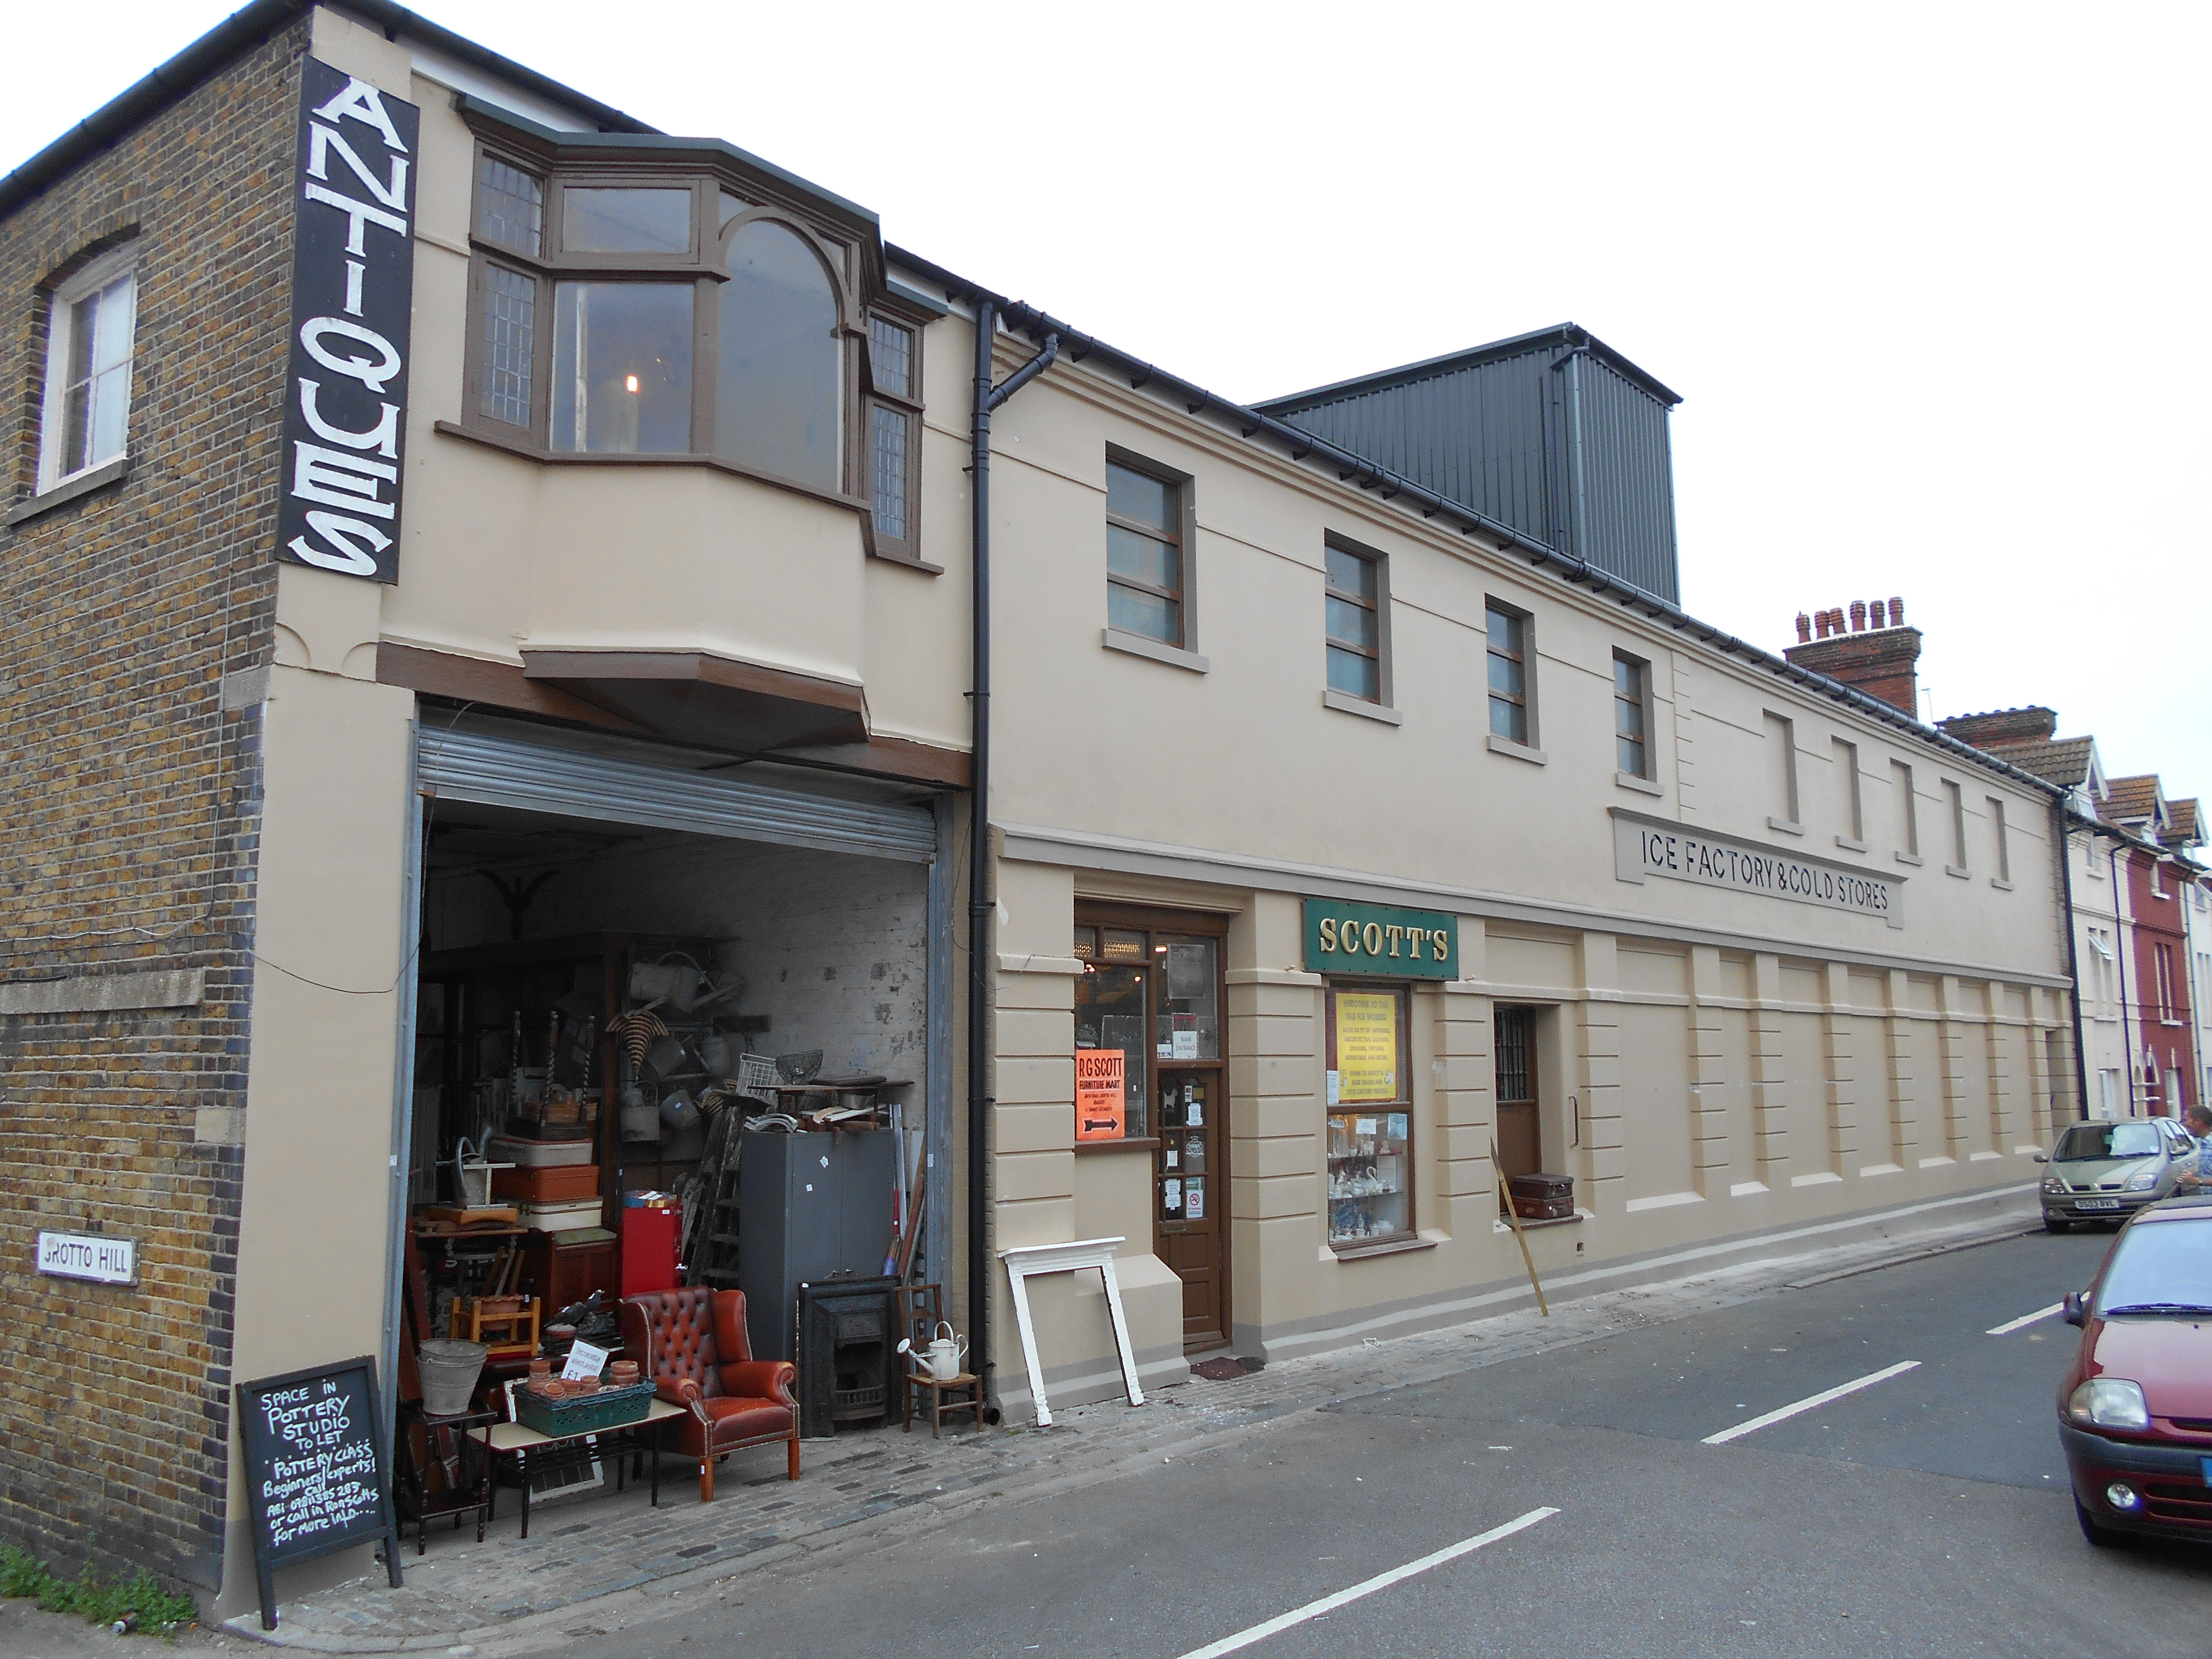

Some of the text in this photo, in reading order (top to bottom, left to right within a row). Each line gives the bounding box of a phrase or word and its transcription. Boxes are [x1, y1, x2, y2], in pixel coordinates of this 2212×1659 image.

[287, 76, 409, 577] ANTIQUES
[1642, 831, 1677, 870] ICE
[1686, 841, 1772, 888] FACTORY
[1838, 876, 1887, 910] STORES
[1320, 918, 1448, 961] SCOTT'S
[1343, 1000, 1369, 1008] WELCOME
[1079, 1057, 1122, 1077] R G SCOTT
[1079, 1079, 1120, 1090] FURNITURE MART
[99, 1247, 128, 1273] HILL
[571, 1357, 584, 1366] plant
[576, 1347, 601, 1362] Terracotta
[261, 1387, 310, 1410] SPACE
[267, 1395, 350, 1434] POTTERY
[295, 1430, 343, 1450] TO LET
[274, 1442, 373, 1480] POTTERY CLASS
[270, 1516, 286, 1529] or
[287, 1507, 309, 1523] call
[311, 1505, 325, 1516] in
